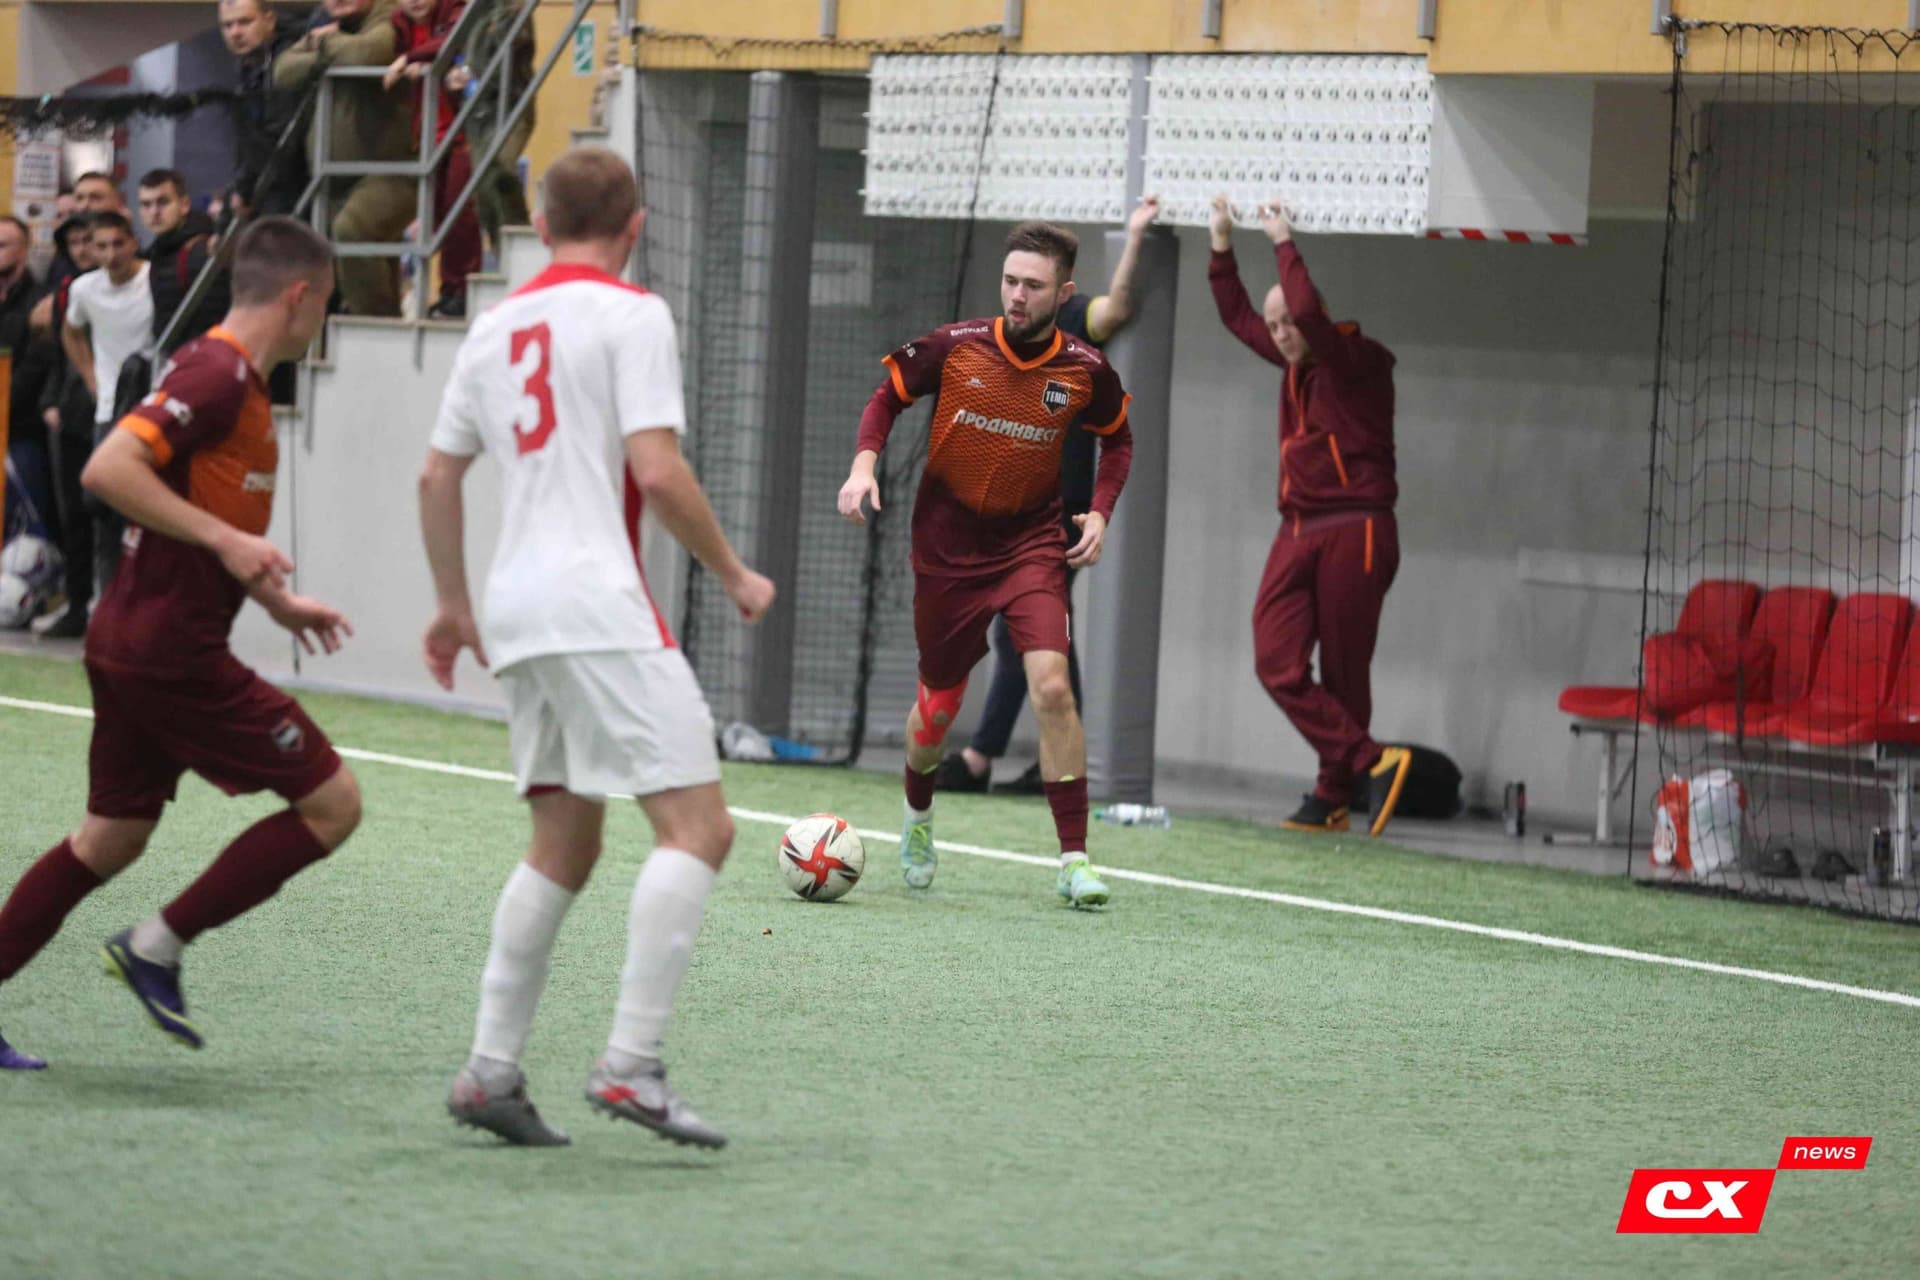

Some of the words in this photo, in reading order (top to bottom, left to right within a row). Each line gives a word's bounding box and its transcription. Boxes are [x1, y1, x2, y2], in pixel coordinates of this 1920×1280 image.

[510, 320, 557, 457] 3
[1045, 391, 1067, 405] ТЕМП
[953, 408, 1059, 442] ПРОДИНВЕСТ
